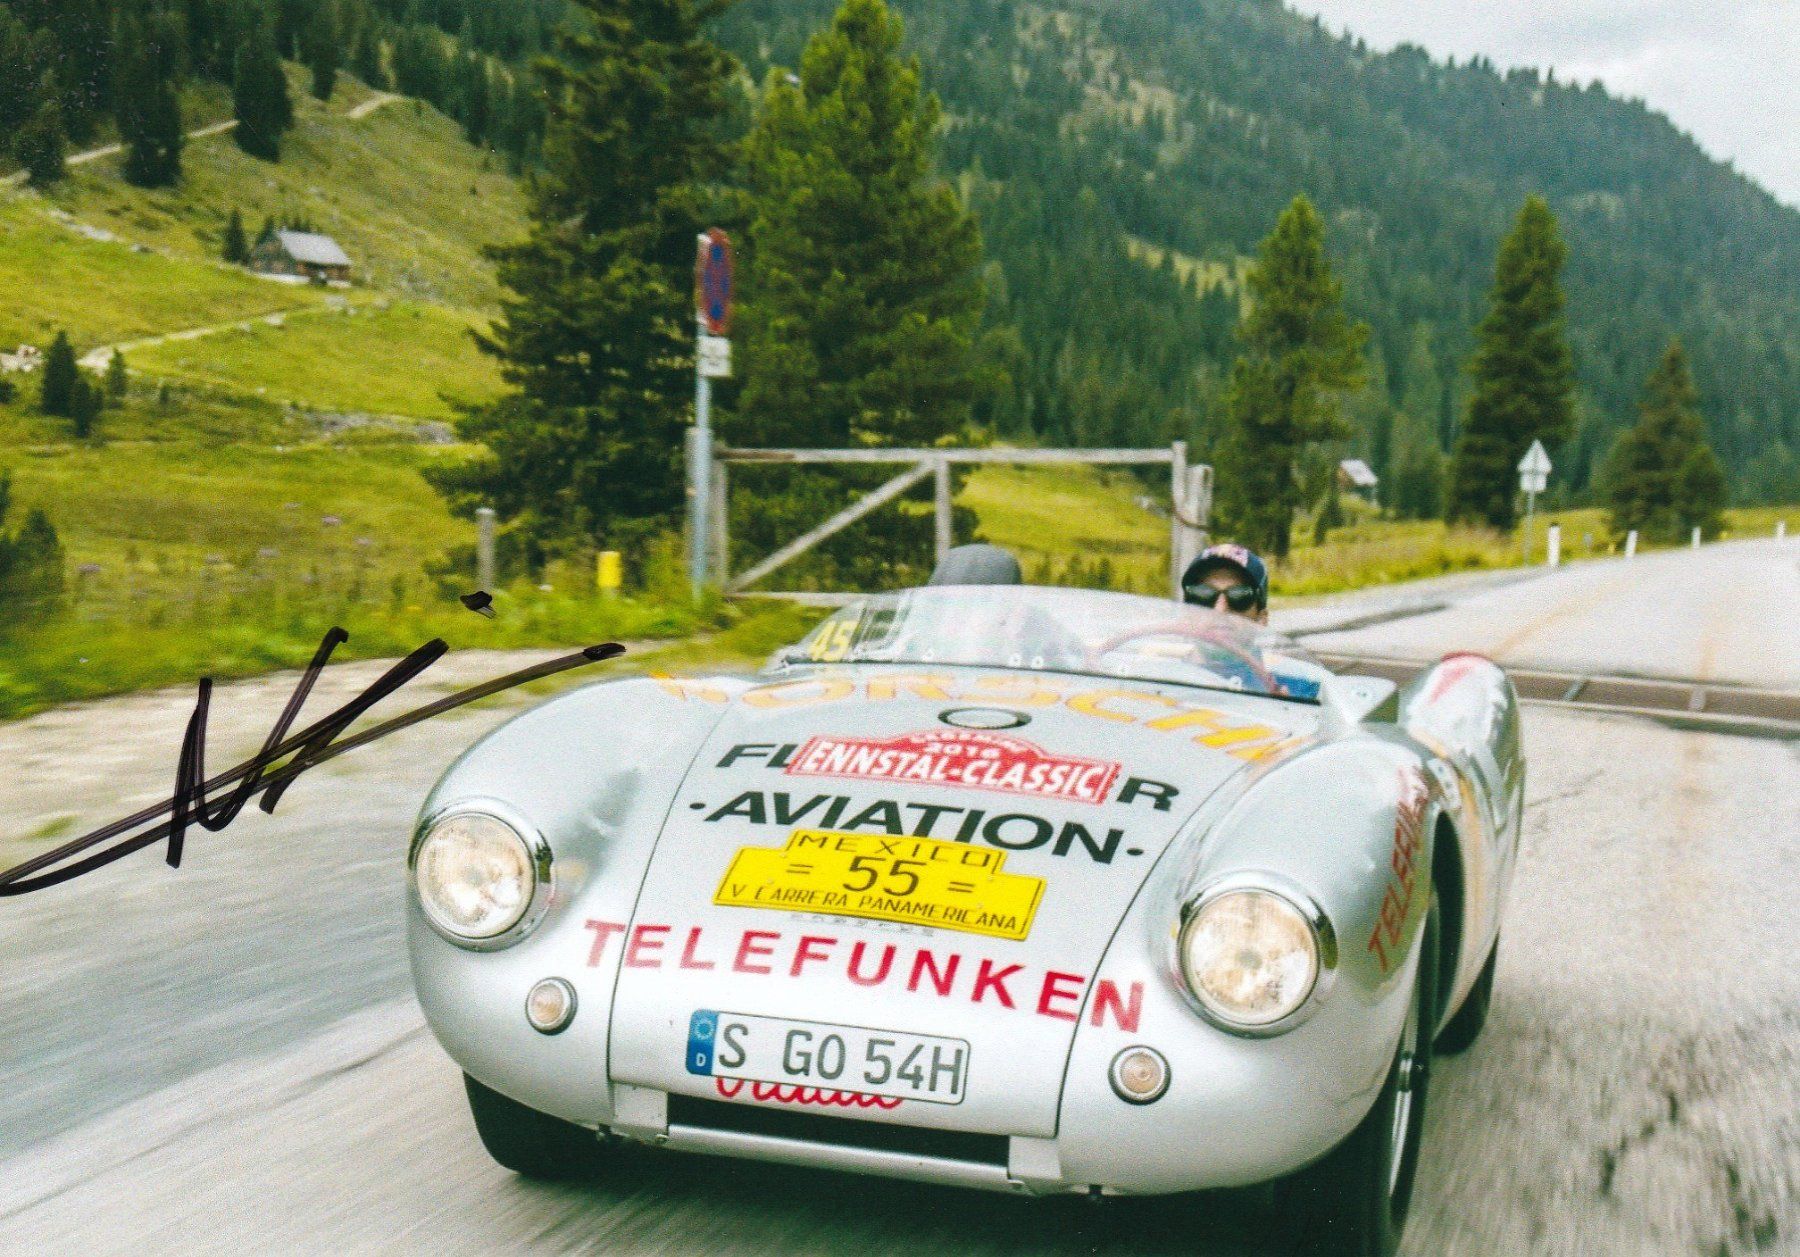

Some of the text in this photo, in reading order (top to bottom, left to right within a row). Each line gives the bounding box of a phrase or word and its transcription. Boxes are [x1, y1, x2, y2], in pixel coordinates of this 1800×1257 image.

[808, 619, 860, 661] 45
[804, 741, 1104, 799] ENNSTAL-CLASSIC
[797, 834, 992, 868] MEXICO
[842, 855, 927, 897] 55
[731, 883, 747, 899] V
[754, 885, 848, 908] CARRERA
[859, 894, 1018, 931] PANAMERICANA
[584, 919, 1145, 1034] TELEFUNKEN
[695, 1052, 707, 1067] D
[718, 1023, 749, 1069] S
[782, 1029, 847, 1081] GO
[863, 1038, 966, 1096] 54H
